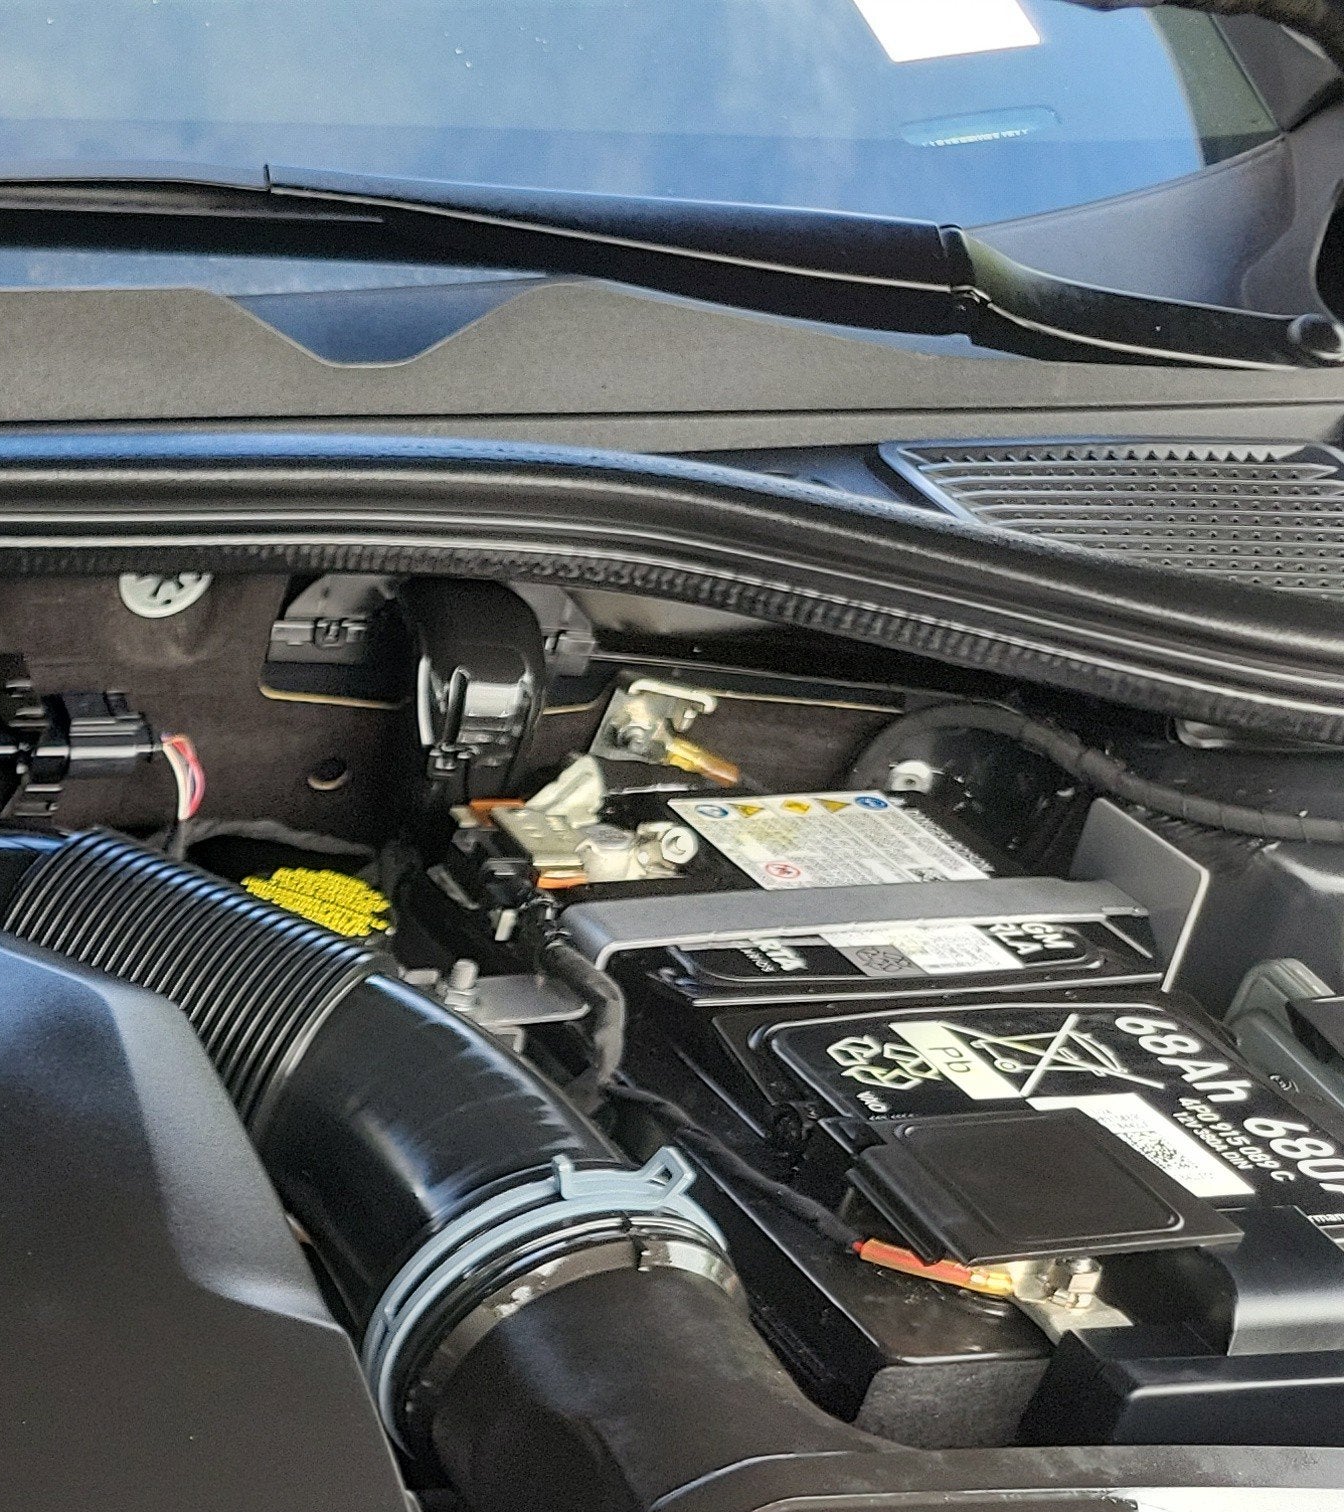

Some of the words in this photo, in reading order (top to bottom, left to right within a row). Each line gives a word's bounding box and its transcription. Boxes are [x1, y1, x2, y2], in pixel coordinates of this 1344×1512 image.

[1020, 922, 1075, 951] GM
[928, 1046, 971, 1075] Pb
[1115, 1016, 1253, 1102] 68Ah
[1243, 1117, 1344, 1195] 680
[1173, 1111, 1203, 1131] 12V
[1221, 1150, 1256, 1171] DIN
[1211, 1119, 1251, 1147] 915
